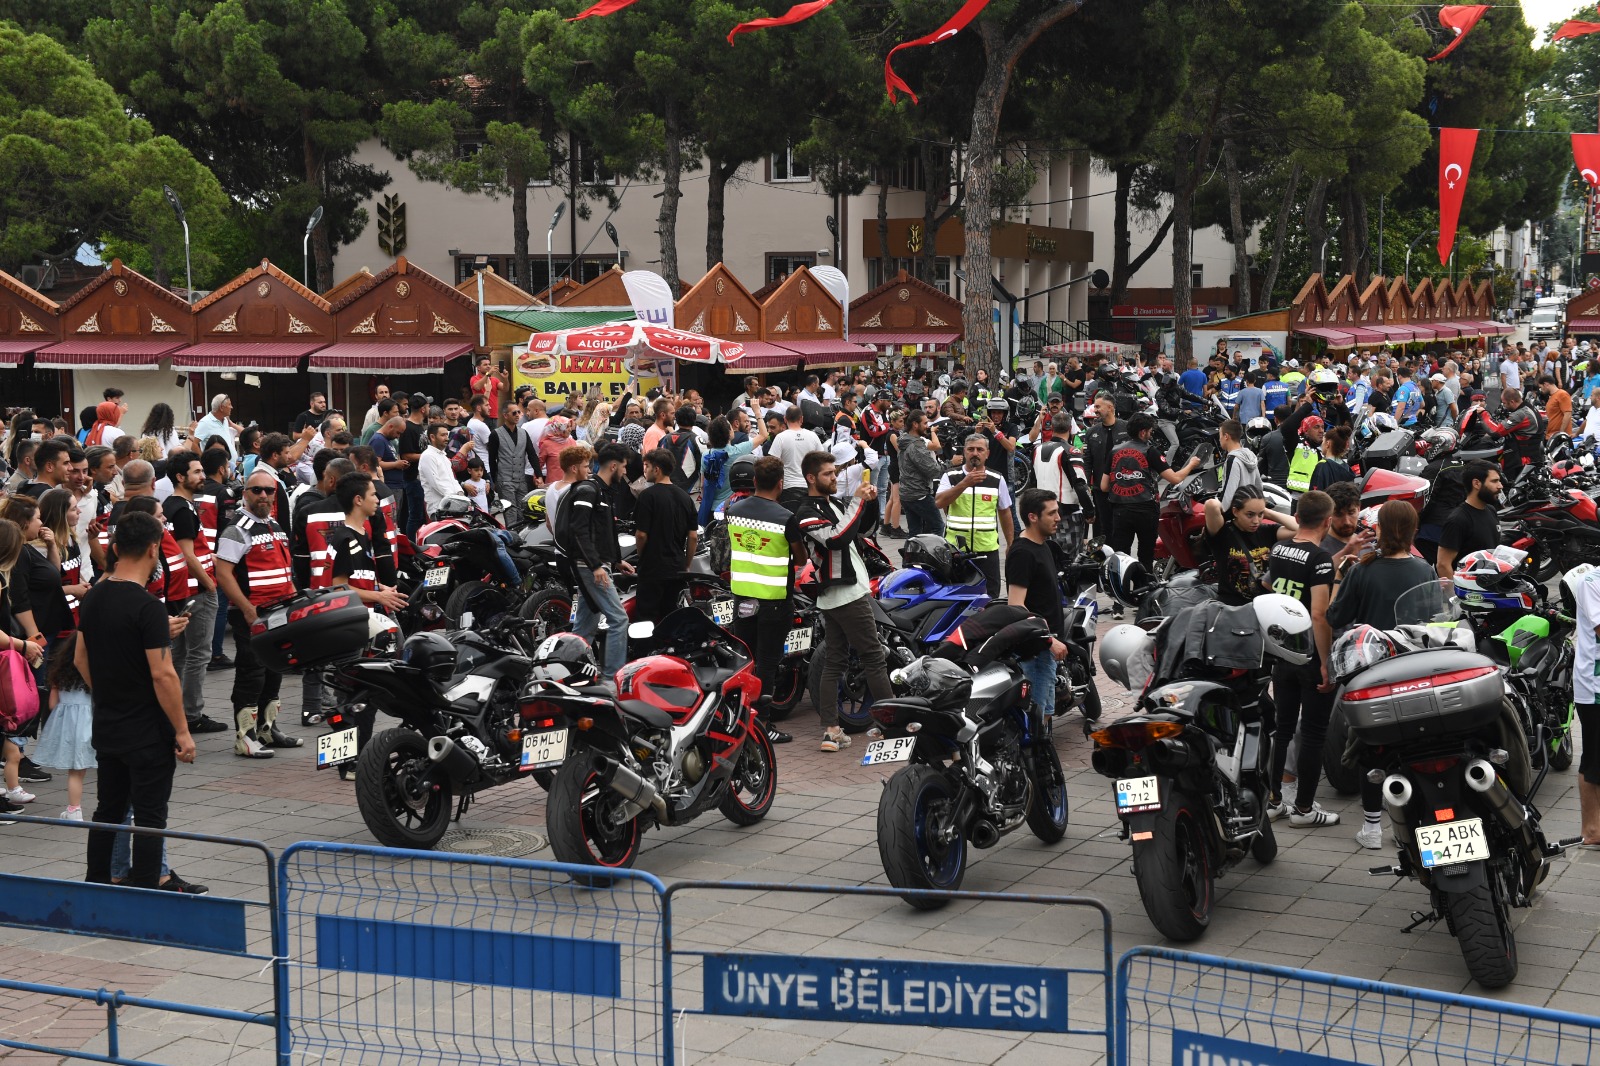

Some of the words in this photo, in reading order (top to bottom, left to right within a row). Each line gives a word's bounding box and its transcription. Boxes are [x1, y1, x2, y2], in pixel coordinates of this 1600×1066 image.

[559, 355, 624, 374] LEZZET
[1279, 545, 1310, 562] YAMAHA
[1271, 577, 1304, 600] 46
[712, 604, 723, 614] 55
[796, 629, 810, 639] AHL
[790, 642, 802, 652] 731
[1392, 681, 1431, 693] SHAD
[321, 736, 332, 750] 52
[343, 730, 354, 744] HK
[525, 736, 539, 748] 06
[539, 731, 564, 746] MLU
[868, 741, 885, 753] 09
[893, 738, 914, 750] BV
[332, 745, 348, 760] 212
[537, 748, 550, 761] 10
[874, 750, 899, 762] 853
[1119, 782, 1132, 792] 06
[1142, 778, 1155, 789] NT
[1131, 792, 1150, 803] 712
[1420, 829, 1443, 846] 52
[1448, 823, 1480, 842] ABK
[1442, 841, 1475, 860] 474
[722, 964, 819, 1007] ÜNYE
[831, 973, 1049, 1019] BELEDİYESİ
